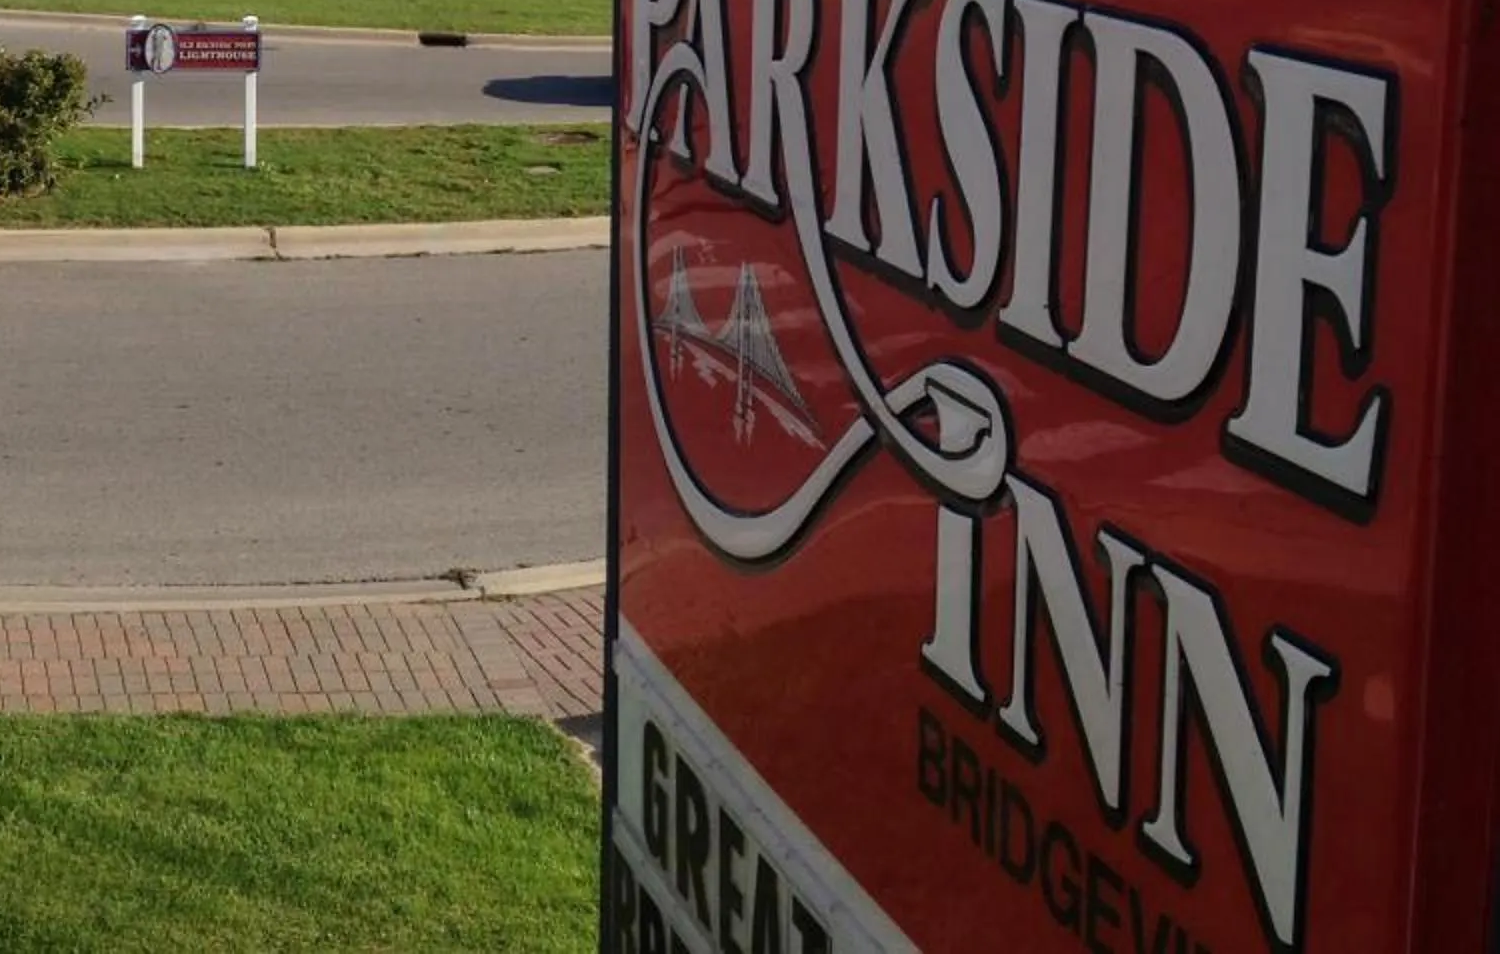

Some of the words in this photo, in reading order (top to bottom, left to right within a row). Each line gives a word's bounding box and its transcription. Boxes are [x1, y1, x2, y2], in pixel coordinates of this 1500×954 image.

[180, 51, 256, 59] LIGHTHOUSE
[918, 706, 1216, 954] BRIDGEV
[920, 471, 1340, 954] INN
